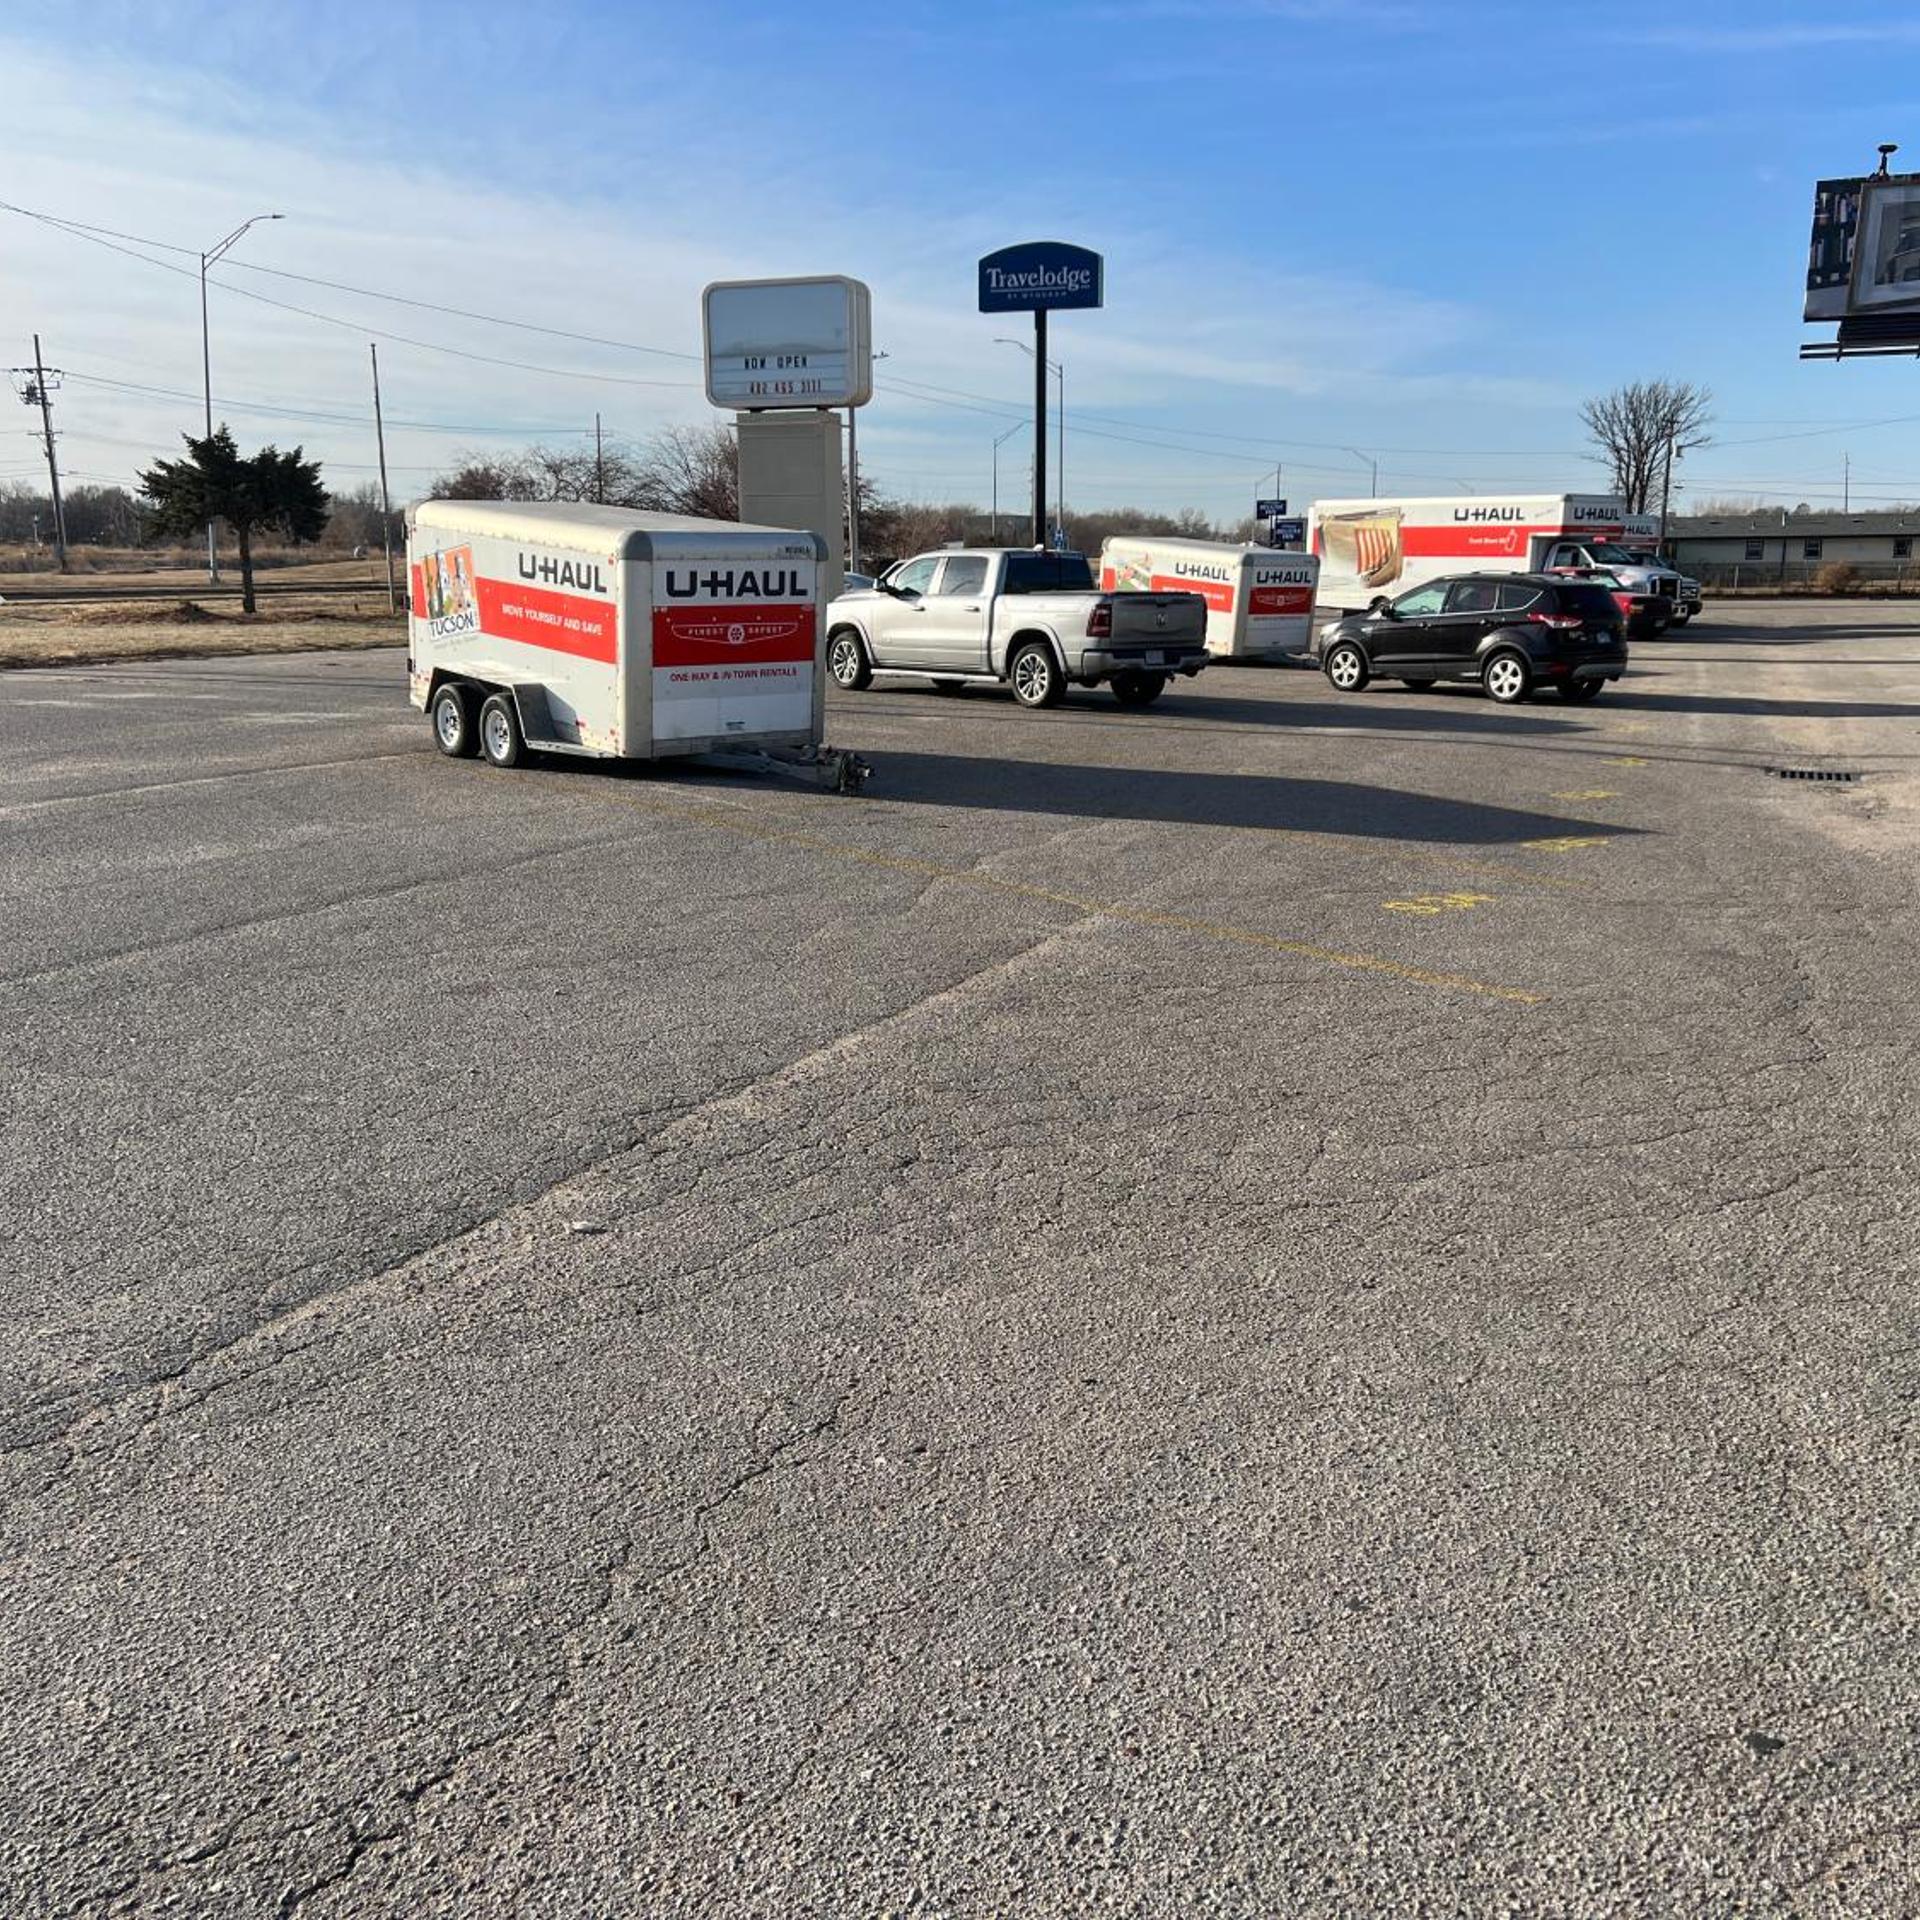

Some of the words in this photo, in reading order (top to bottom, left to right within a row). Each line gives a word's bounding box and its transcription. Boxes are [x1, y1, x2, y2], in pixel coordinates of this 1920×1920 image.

[986, 264, 1091, 291] Travelodge
[744, 357, 766, 369] NOW
[777, 355, 807, 369] OPEN
[1454, 507, 1525, 521] U-HAUL
[1574, 507, 1621, 521] U-HAUL
[518, 551, 608, 593] U-HAUL
[1175, 562, 1231, 581] U-HAUL
[1256, 570, 1313, 584] U-HAUL
[666, 570, 808, 598] U-HAUL
[428, 610, 475, 638] TUCSON
[501, 603, 524, 618] MOVE
[524, 608, 563, 627] YOURSELF
[563, 617, 581, 631] AND
[581, 621, 603, 636] SAVE
[760, 667, 797, 678] RENTALS
